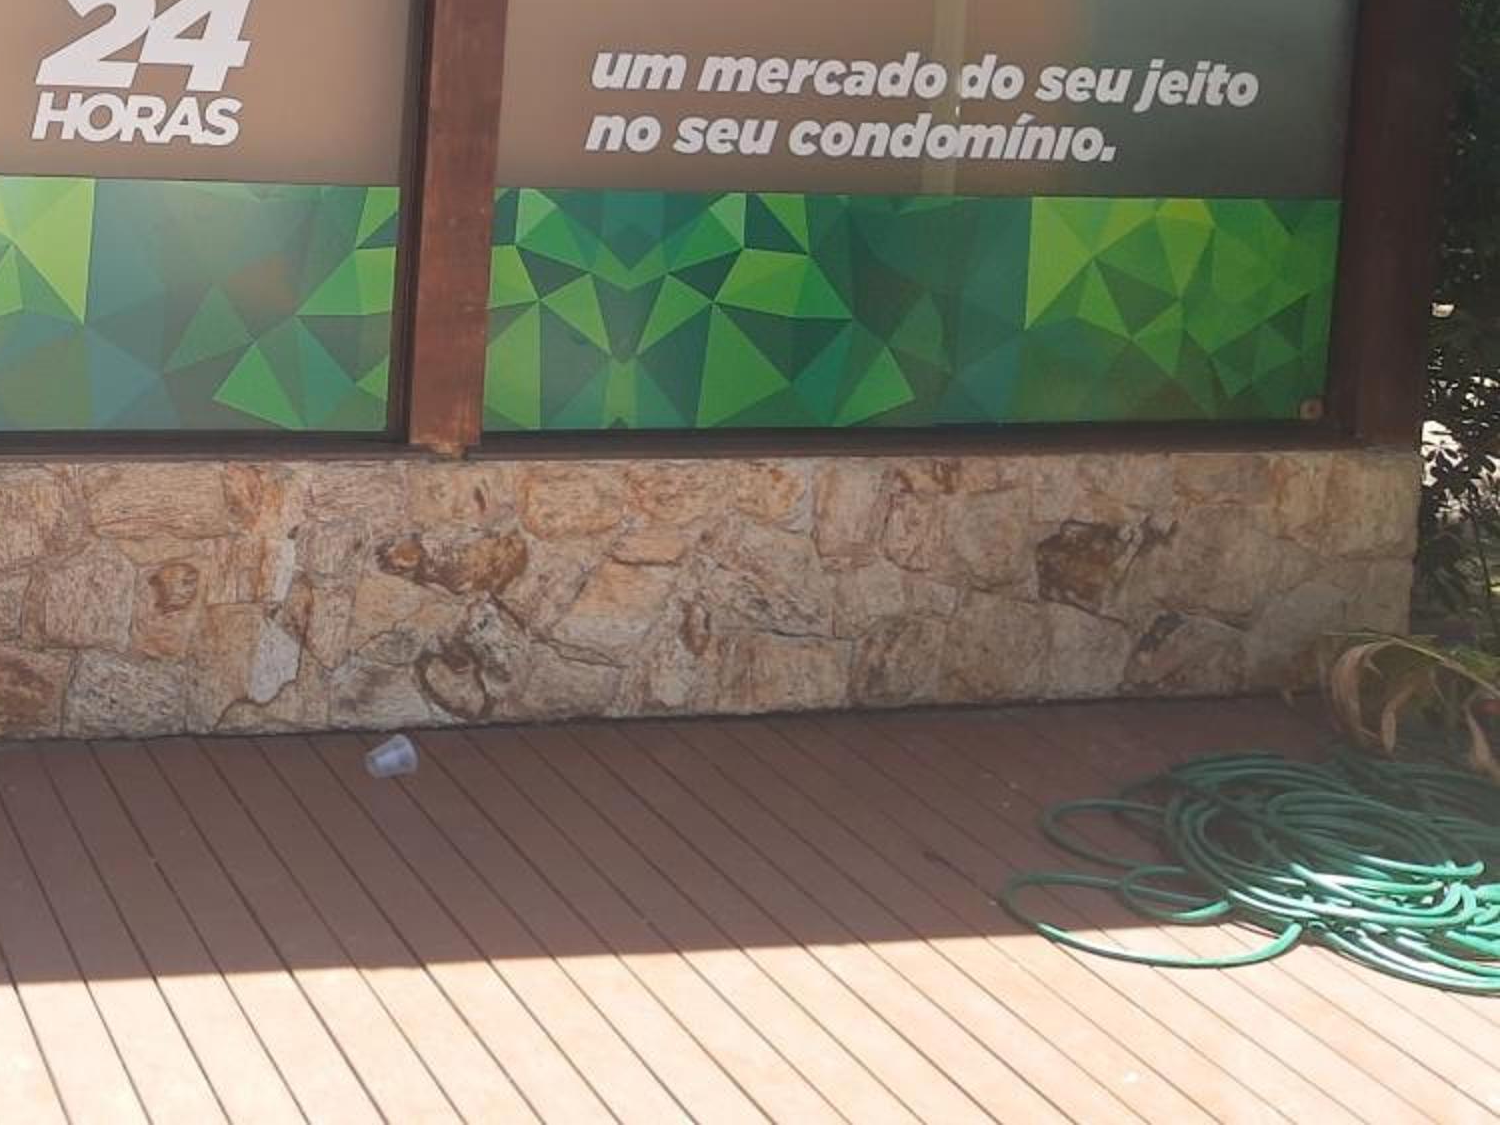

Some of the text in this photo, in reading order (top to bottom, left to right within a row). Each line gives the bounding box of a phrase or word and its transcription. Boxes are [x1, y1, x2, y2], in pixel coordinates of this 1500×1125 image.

[591, 51, 1260, 113] um mercado do seu jeito
[30, 91, 244, 147] HORAS
[584, 112, 1117, 162] no seu condomínio.
